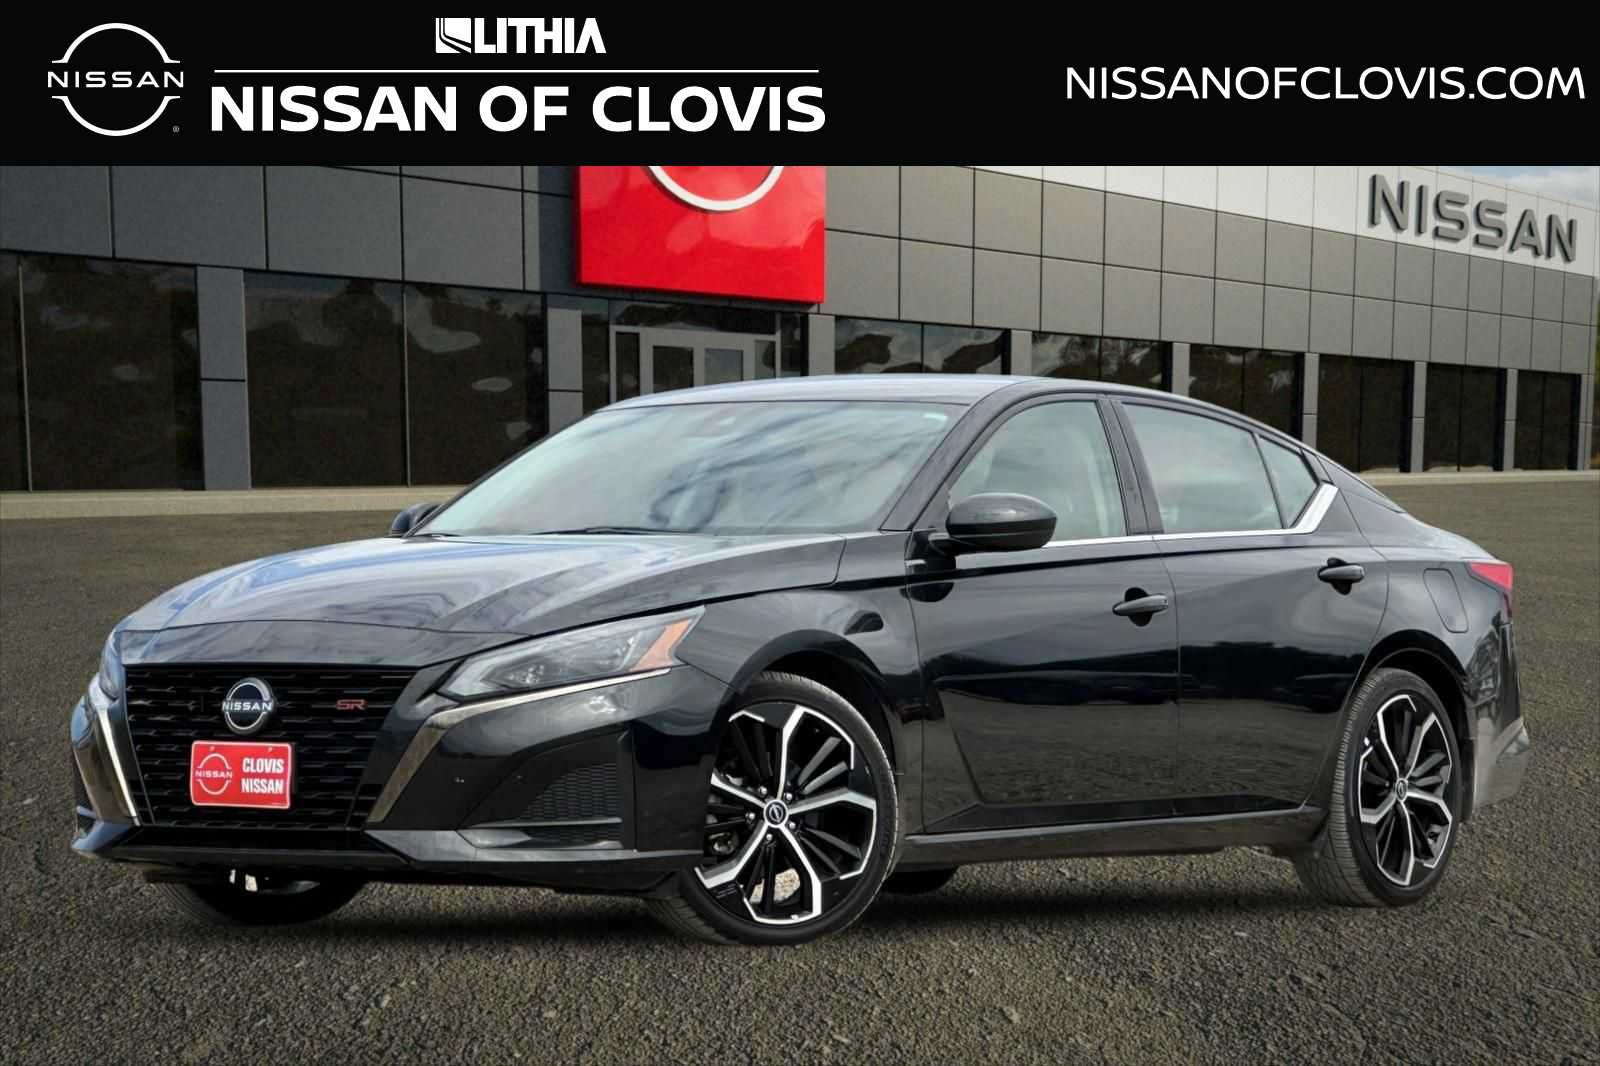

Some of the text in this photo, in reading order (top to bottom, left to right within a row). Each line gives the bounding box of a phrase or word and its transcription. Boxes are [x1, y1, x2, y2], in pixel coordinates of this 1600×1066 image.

[1367, 174, 1578, 263] NISSAN
[221, 700, 273, 712] NISSAN
[336, 699, 367, 711] SR
[241, 757, 285, 774] CLOVIS
[194, 769, 233, 779] NISSAN
[240, 778, 284, 794] NISSAN
